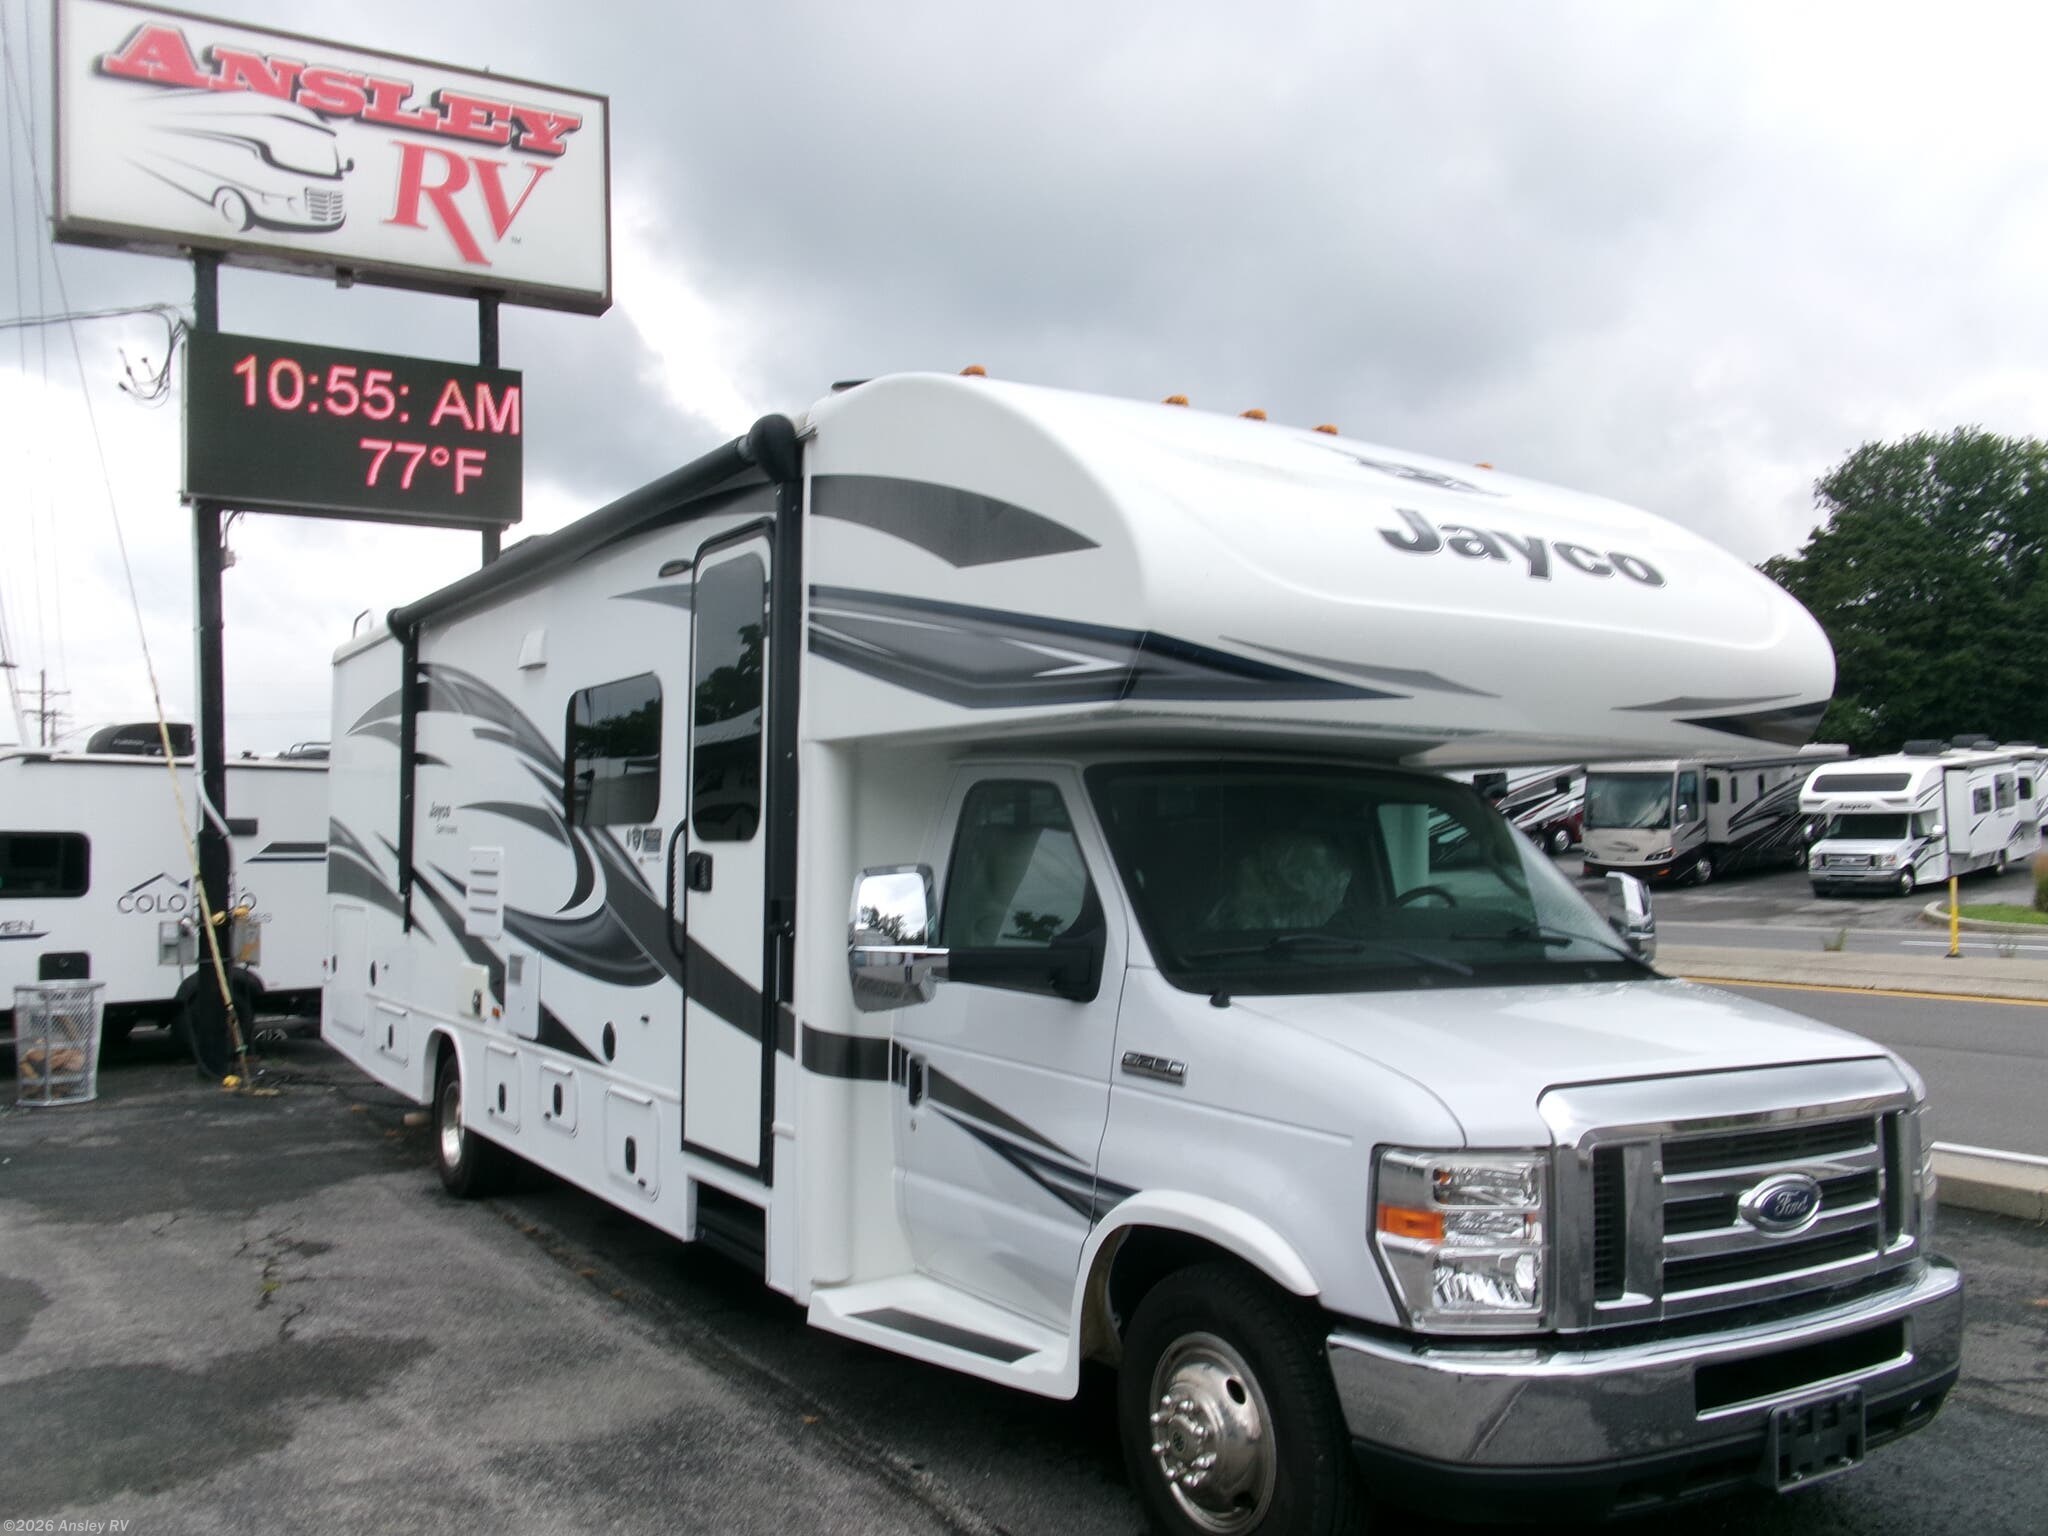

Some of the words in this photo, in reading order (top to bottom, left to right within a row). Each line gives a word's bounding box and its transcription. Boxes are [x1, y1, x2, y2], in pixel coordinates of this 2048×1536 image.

[94, 22, 582, 156] ANSLEY
[382, 140, 552, 267] RV
[429, 379, 521, 436] AM
[360, 438, 487, 495] 77°F
[1377, 506, 1667, 588] Jayco
[1774, 1190, 1810, 1217] Ford
